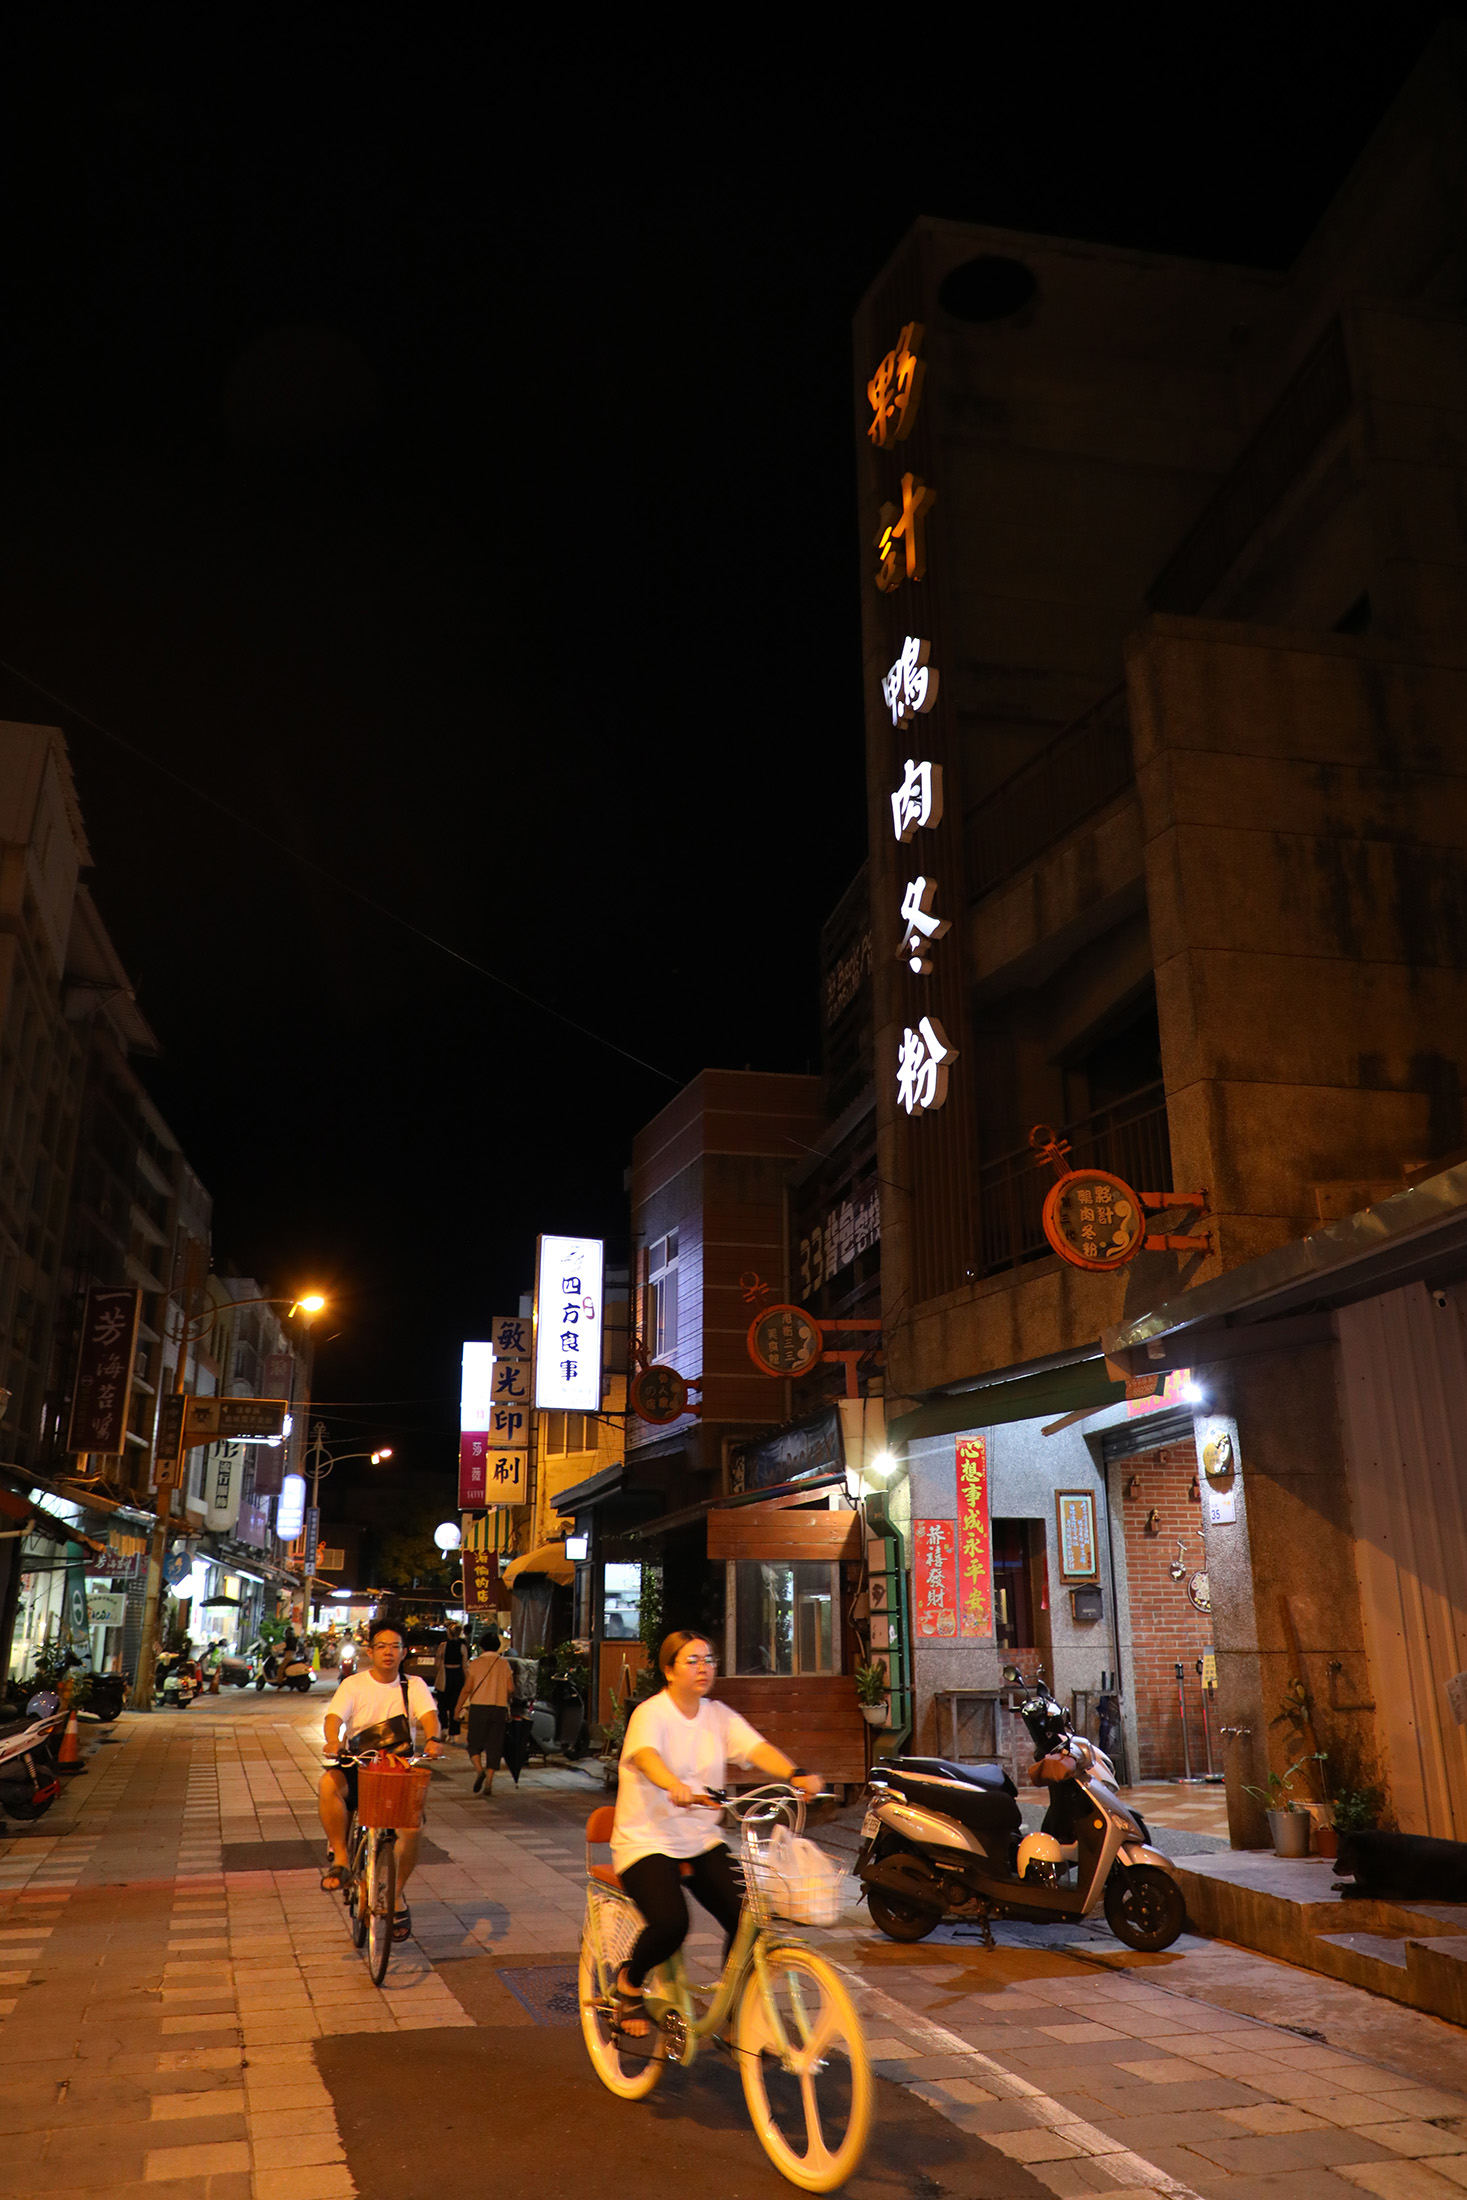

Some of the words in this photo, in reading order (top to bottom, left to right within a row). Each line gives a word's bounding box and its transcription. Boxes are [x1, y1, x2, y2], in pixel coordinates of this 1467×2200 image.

[1077, 1188, 1097, 1258] 鴨肉冬粉
[560, 1276, 582, 1381] 四方食事
[491, 1321, 527, 1485] 敏光印刷
[960, 1441, 988, 1612] 心想事成永平安
[1211, 1509, 1221, 1520] 35
[926, 1525, 948, 1608] 恭禧發財
